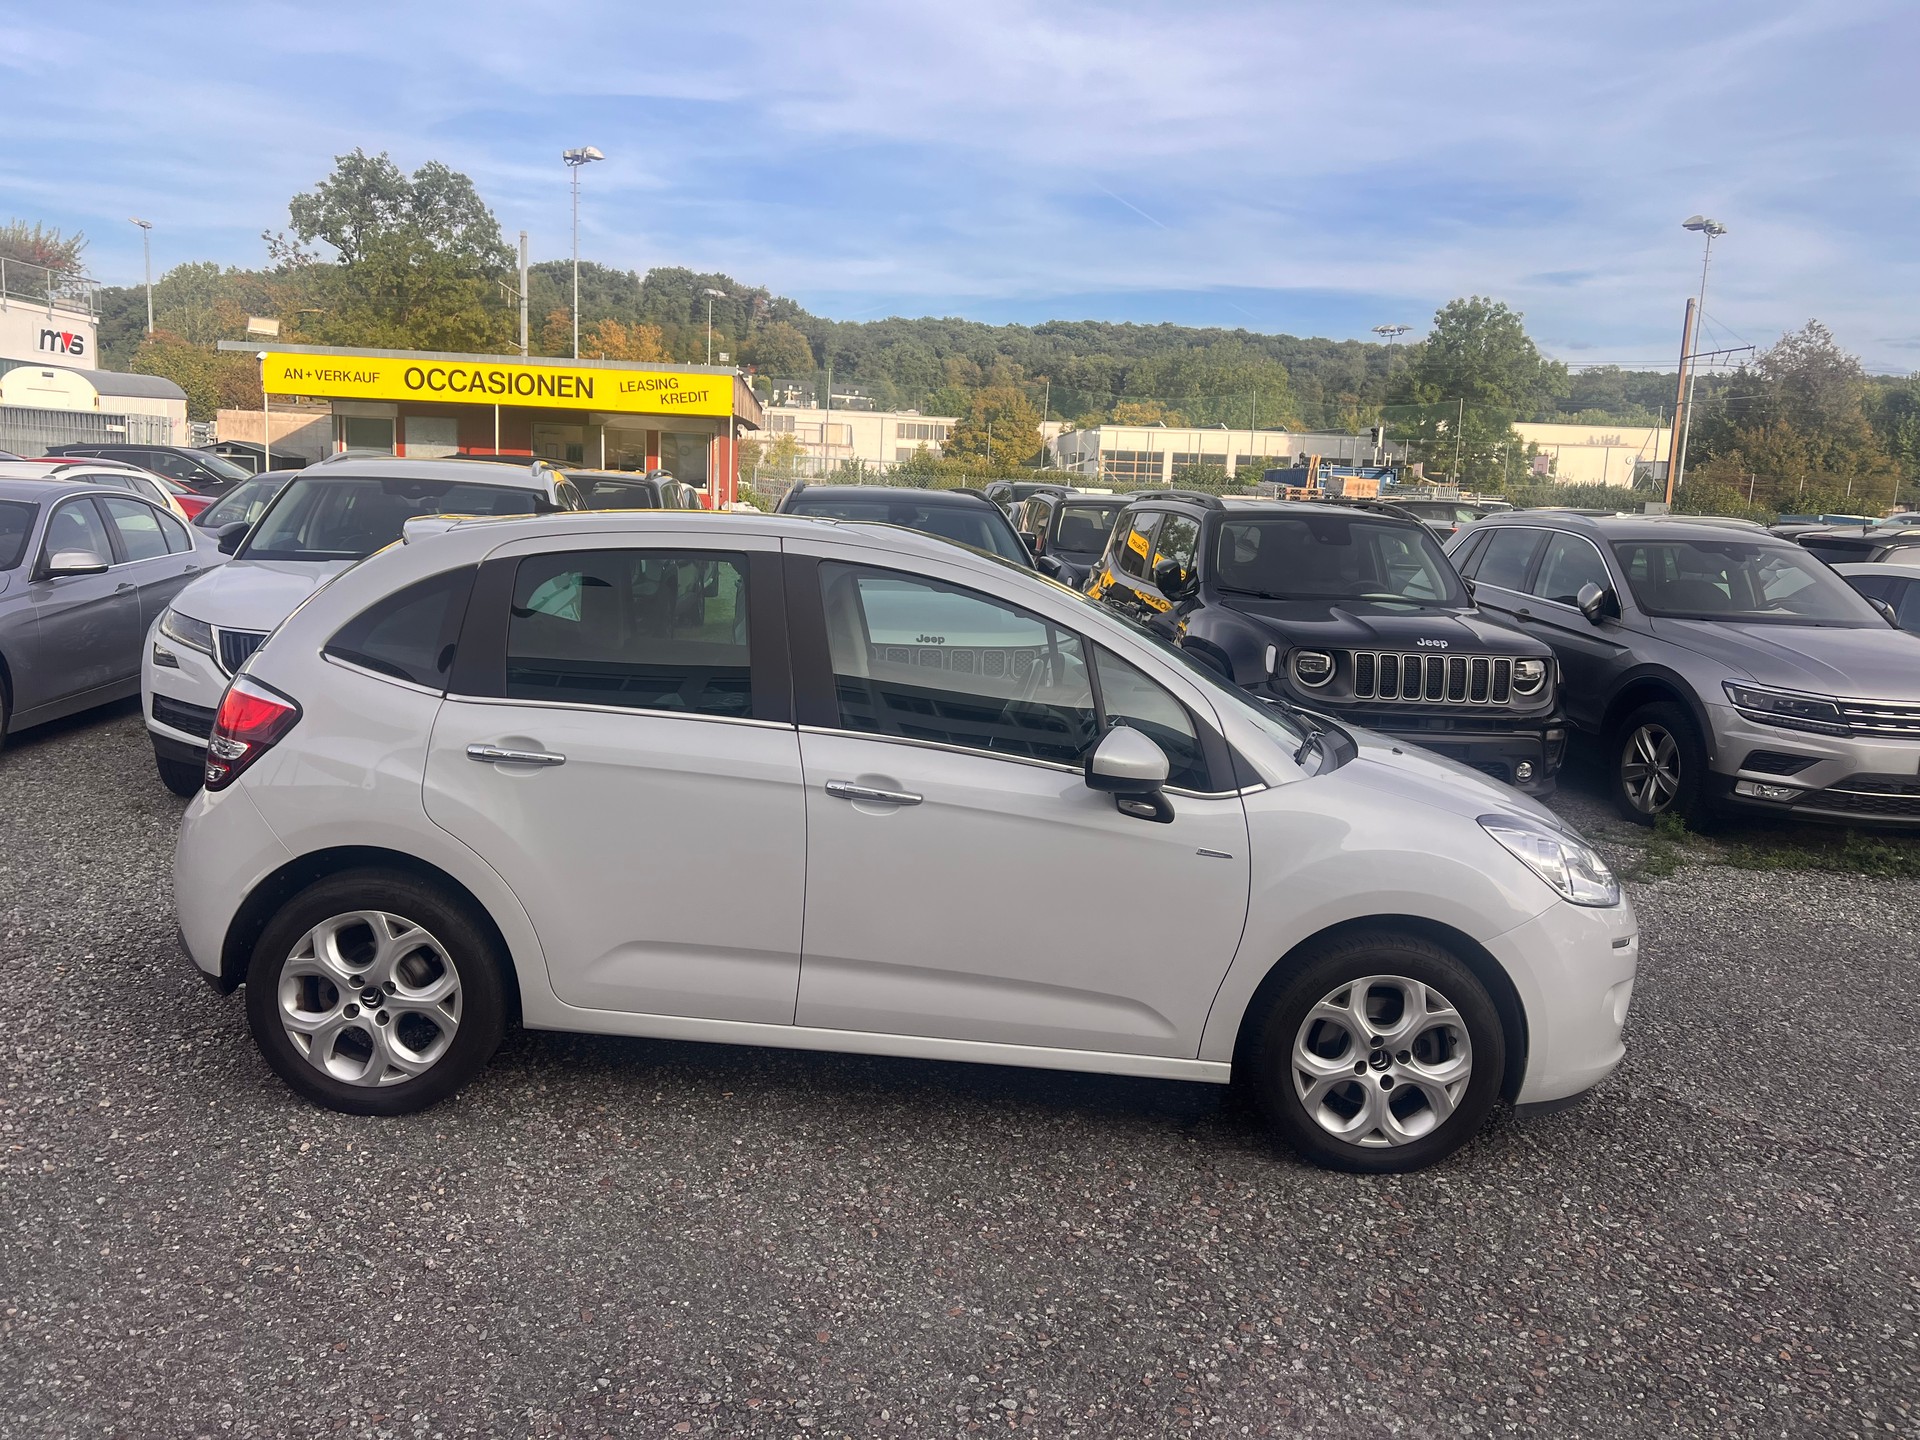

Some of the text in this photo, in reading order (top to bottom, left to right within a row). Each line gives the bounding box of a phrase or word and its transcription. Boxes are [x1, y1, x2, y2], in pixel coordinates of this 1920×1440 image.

[283, 367, 381, 384] AN + VERKAUF
[403, 366, 594, 399] OCCASIONEN
[619, 377, 679, 393] LEASING
[660, 390, 710, 405] KREDIT
[915, 634, 946, 645] Jeep
[1416, 637, 1449, 649] Jeep
